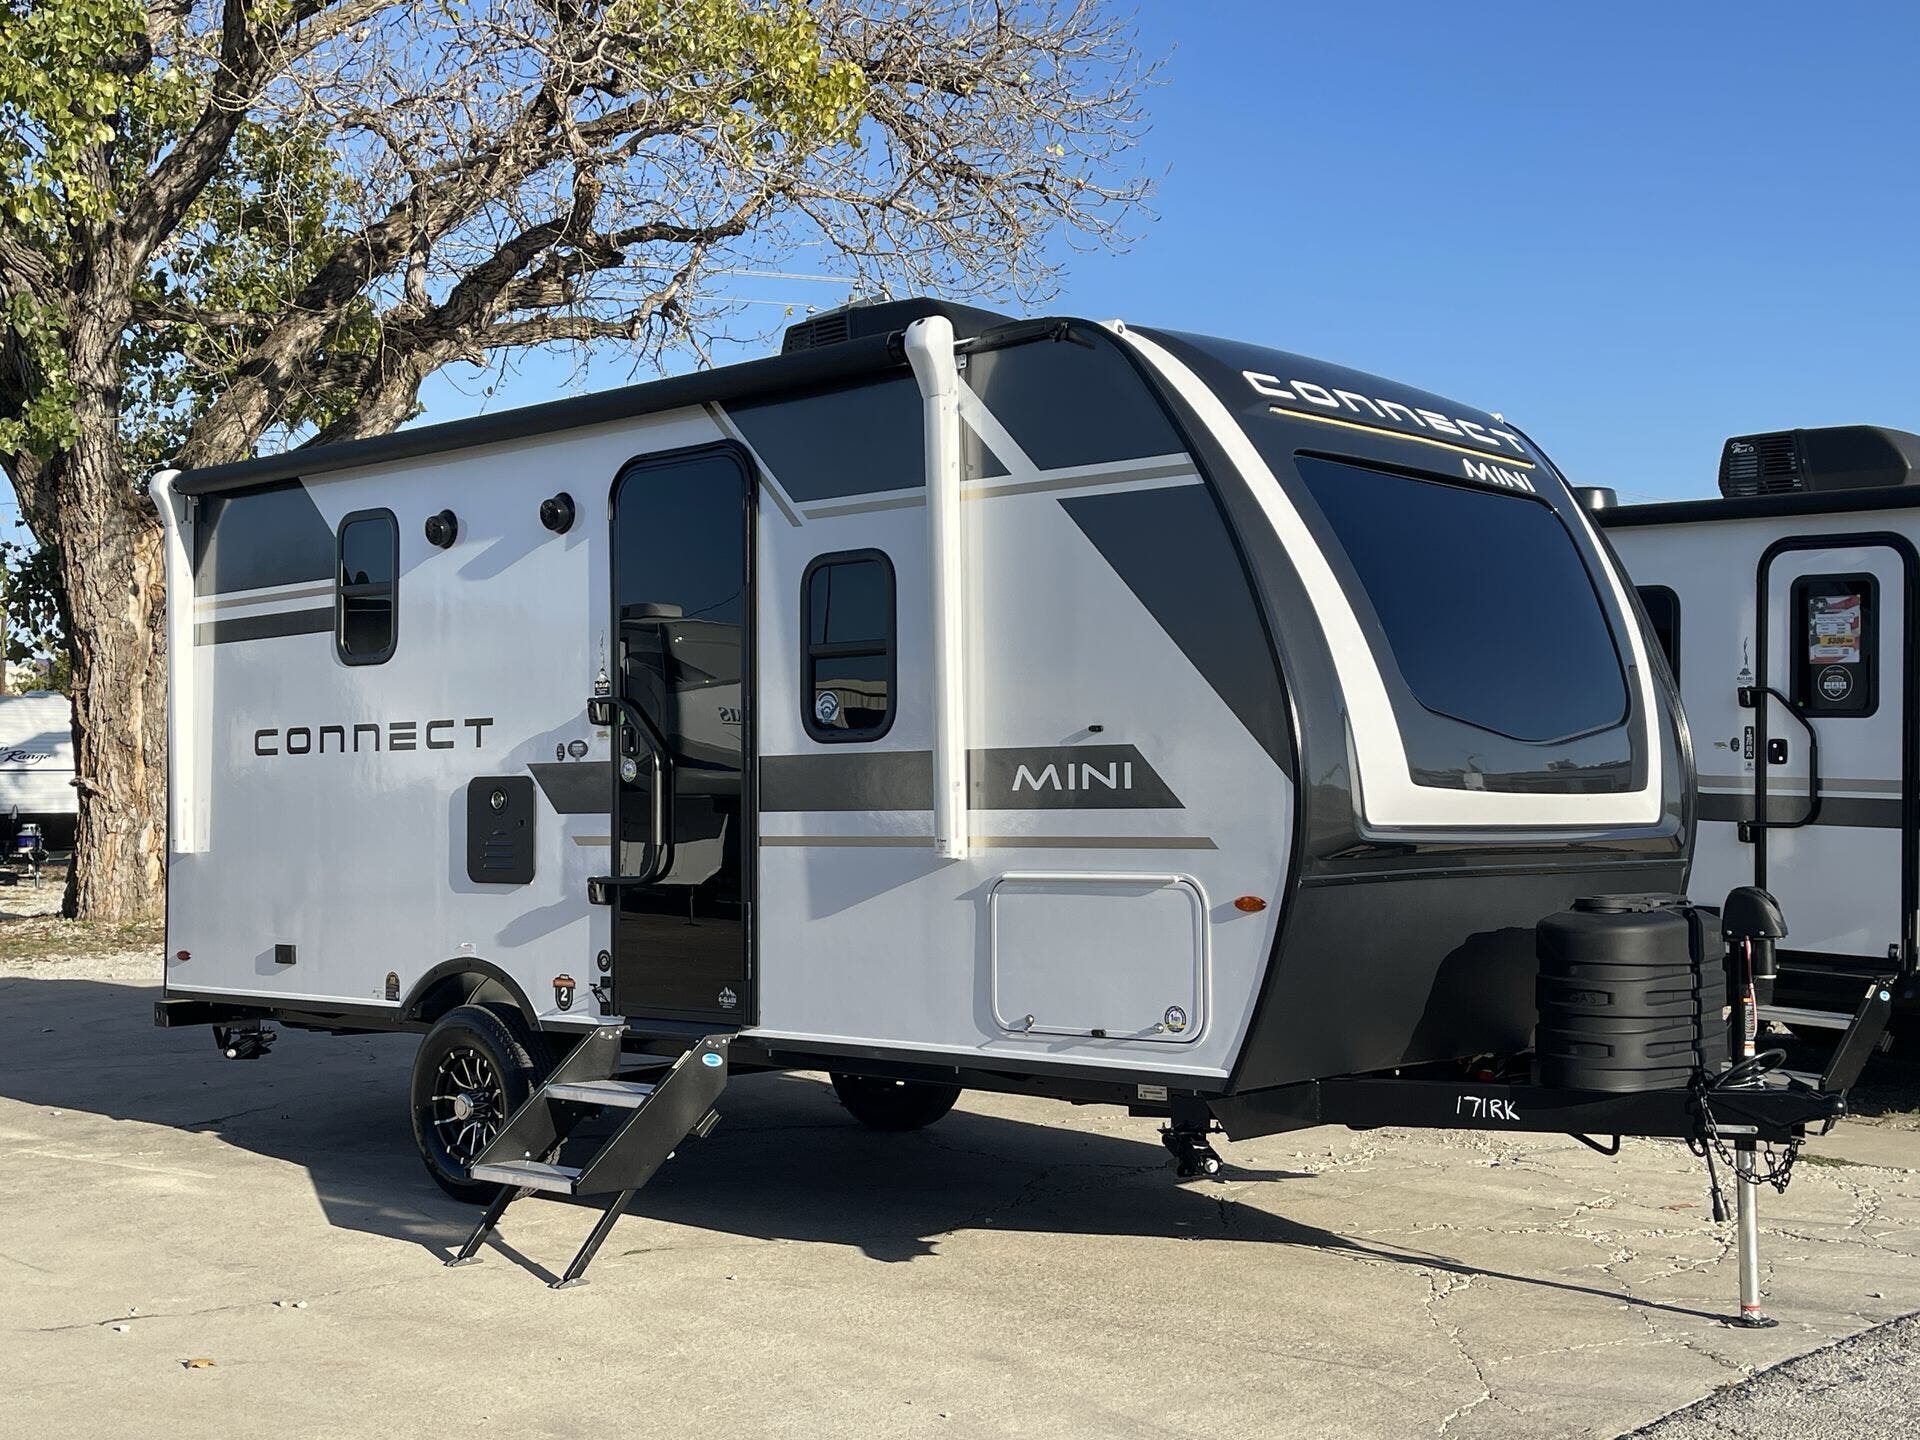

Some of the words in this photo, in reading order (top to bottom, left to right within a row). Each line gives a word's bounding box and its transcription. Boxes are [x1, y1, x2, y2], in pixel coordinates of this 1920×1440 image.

[1243, 370, 1525, 453] CONNECT
[1463, 458, 1536, 493] MINI
[254, 717, 494, 756] CONNECT
[1012, 762, 1132, 791] MINI
[560, 986, 569, 1002] 2
[1456, 1095, 1520, 1120] 171RK
